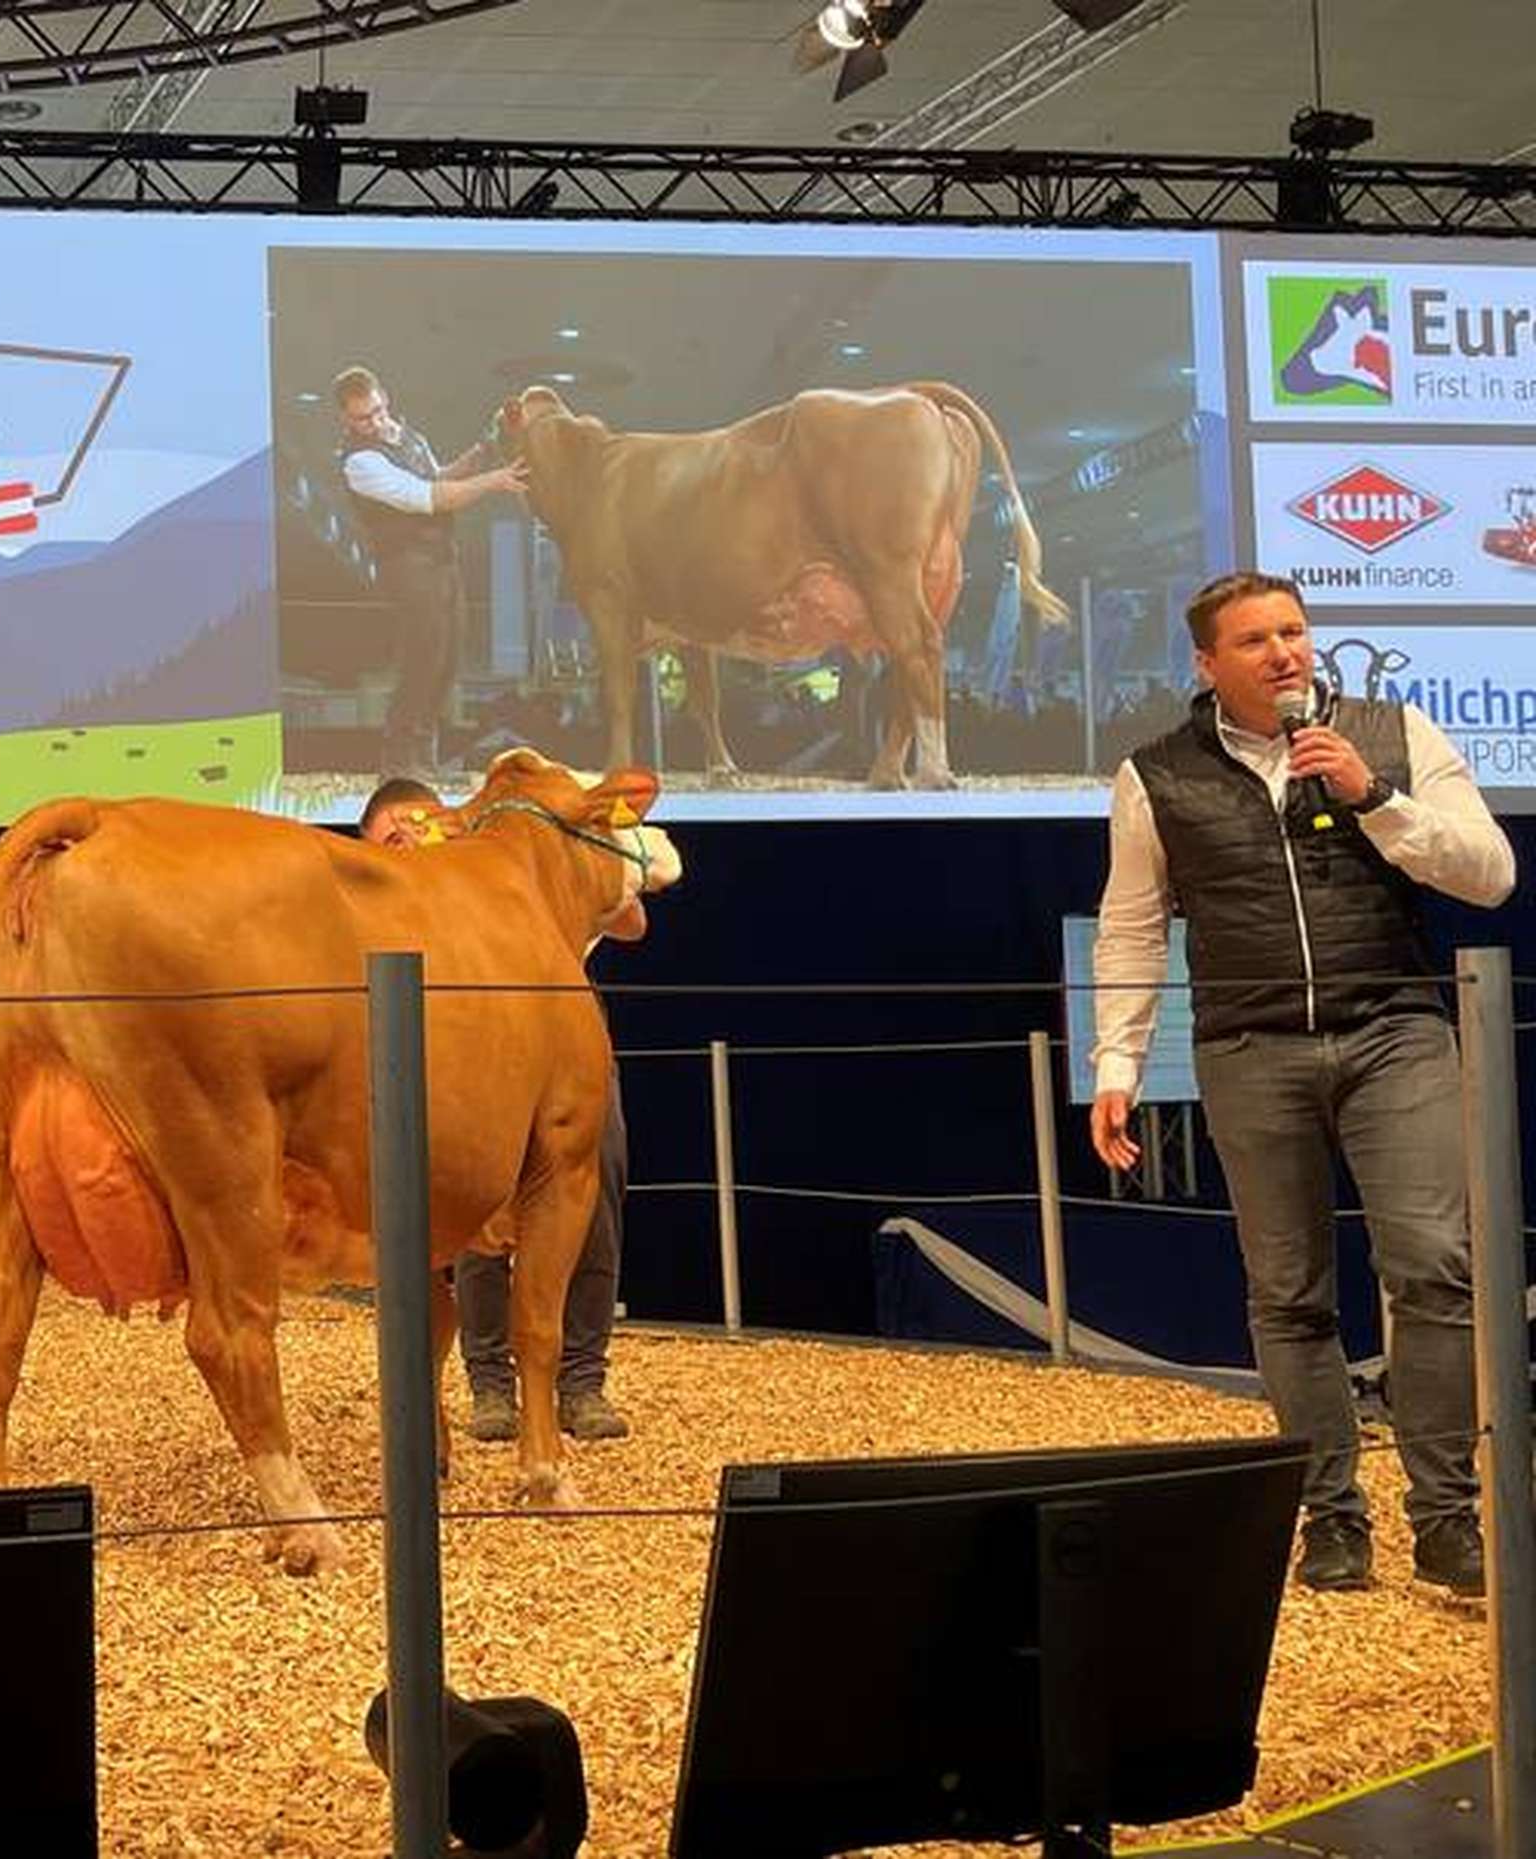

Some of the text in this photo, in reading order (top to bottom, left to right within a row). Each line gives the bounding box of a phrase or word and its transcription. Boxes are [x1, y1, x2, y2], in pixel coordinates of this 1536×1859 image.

[1410, 289, 1536, 357] Eur
[1414, 371, 1470, 398] First
[1480, 372, 1505, 398] in
[1316, 492, 1422, 522] KUHN
[1460, 738, 1536, 775] POR
